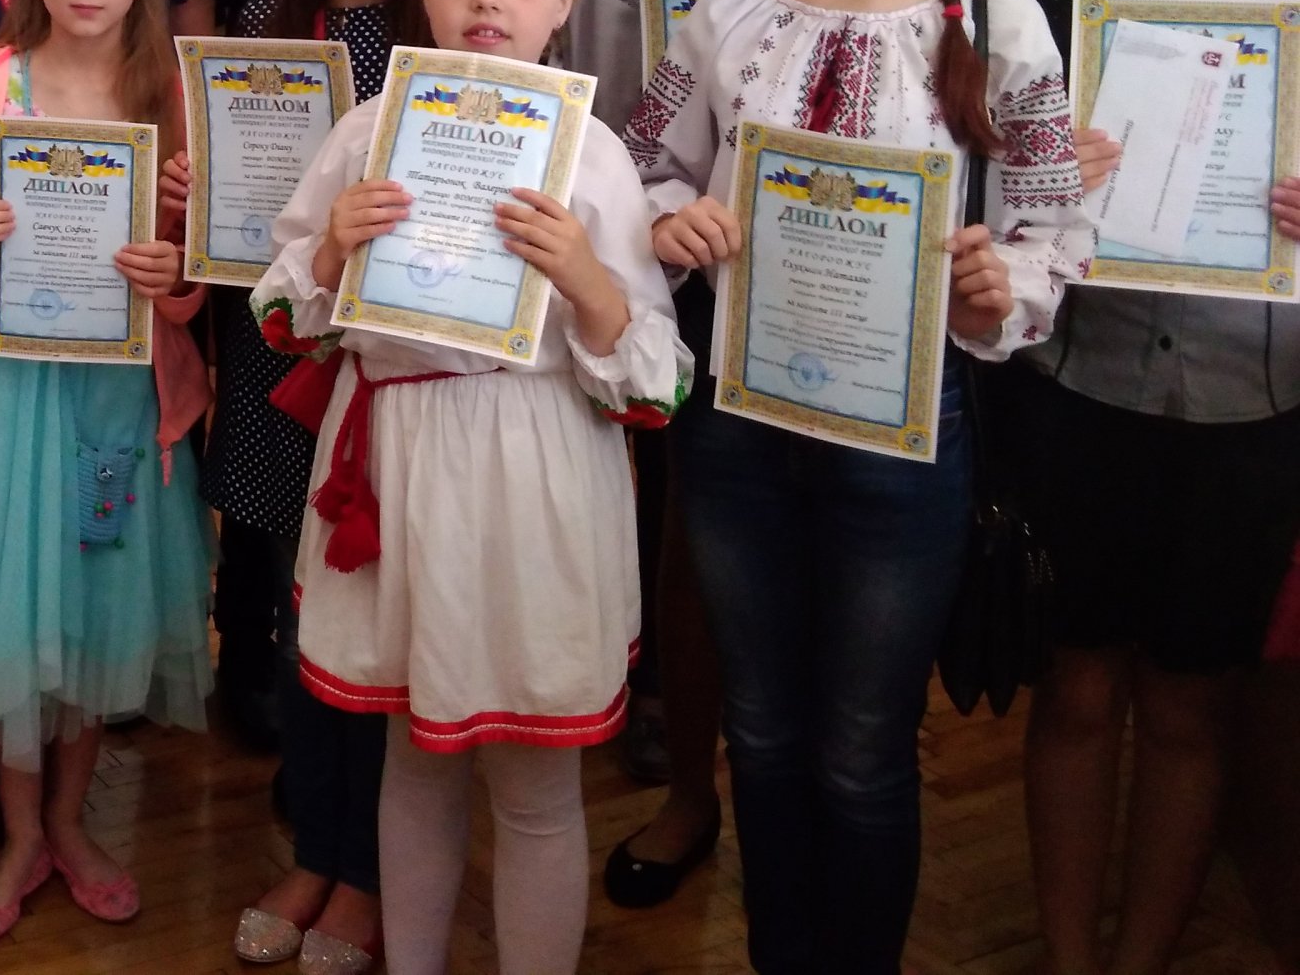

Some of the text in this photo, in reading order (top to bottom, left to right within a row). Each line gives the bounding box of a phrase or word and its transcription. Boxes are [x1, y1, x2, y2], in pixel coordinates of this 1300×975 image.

[228, 97, 311, 113] ДИПЛОМ
[421, 121, 526, 150] ДИПЛОМ
[23, 178, 110, 196] ДИПЛОМ
[33, 222, 62, 233] Савчук
[65, 224, 91, 235] Софію
[777, 205, 888, 238] ДИПЛОМ
